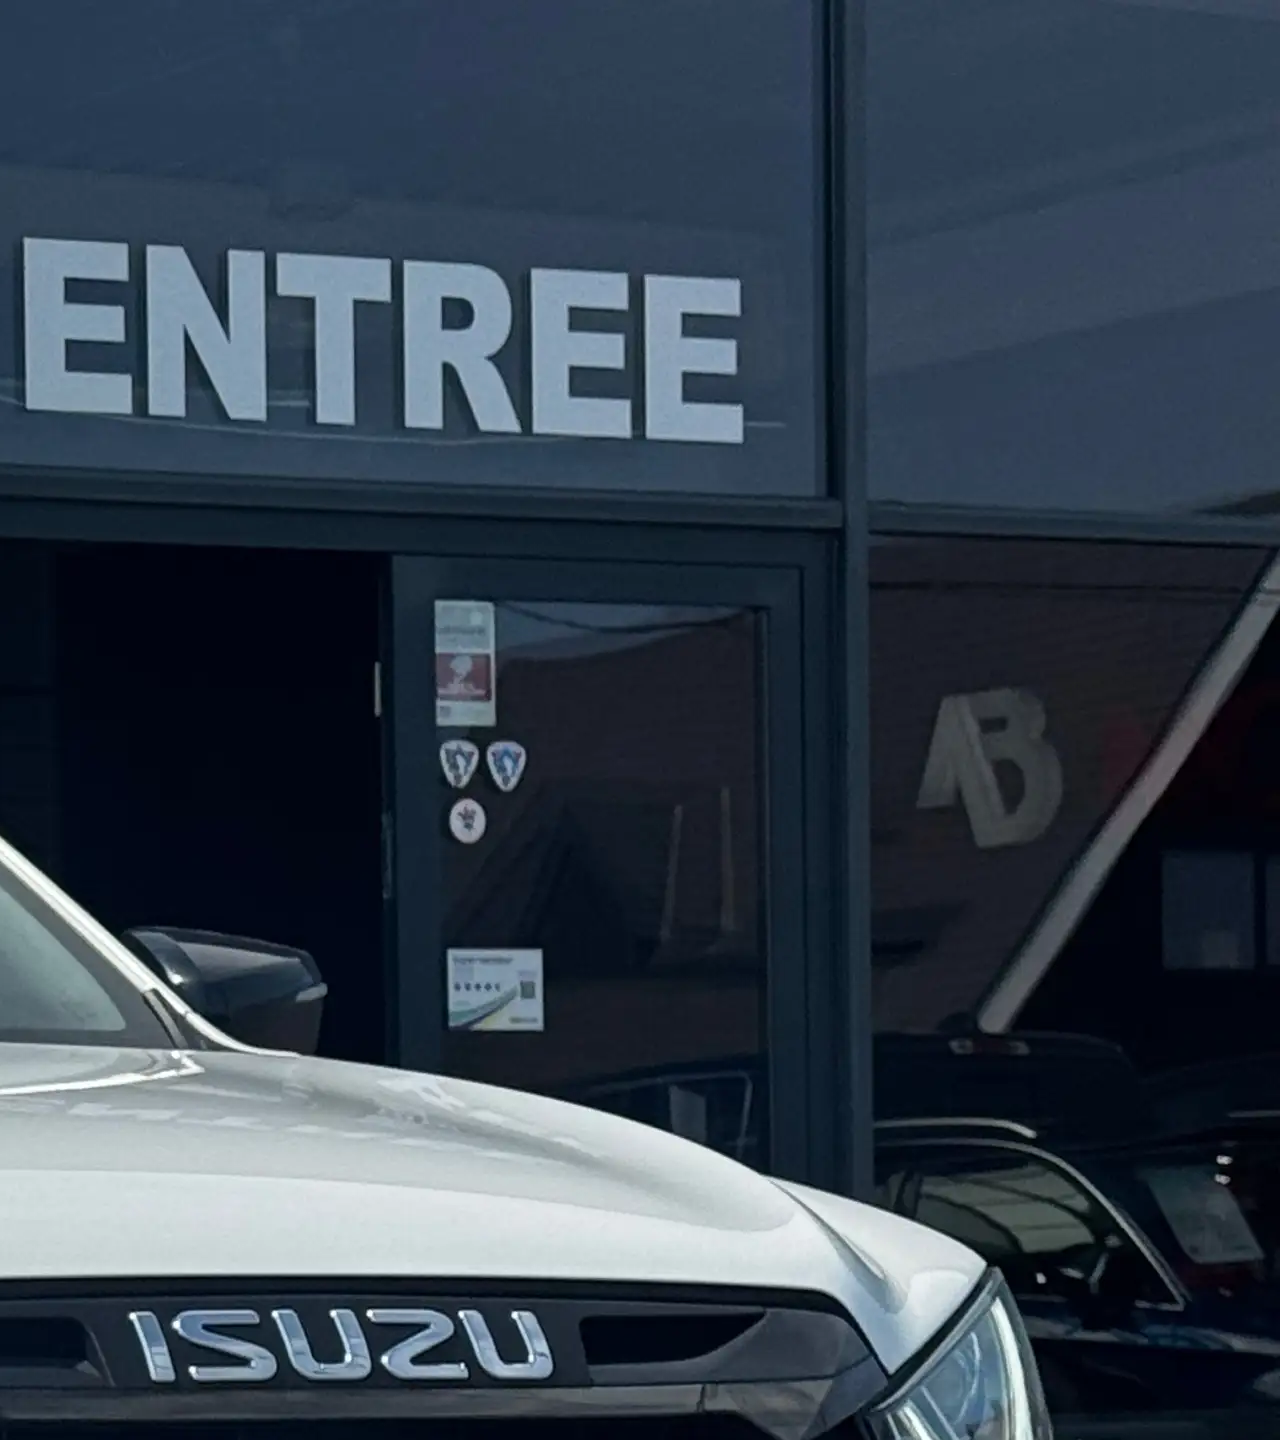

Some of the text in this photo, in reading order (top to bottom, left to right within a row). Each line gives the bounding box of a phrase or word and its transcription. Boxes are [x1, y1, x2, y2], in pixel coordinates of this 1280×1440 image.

[22, 236, 745, 445] ENTREE
[915, 687, 1063, 849] AB
[128, 1308, 555, 1383] ISUZU
